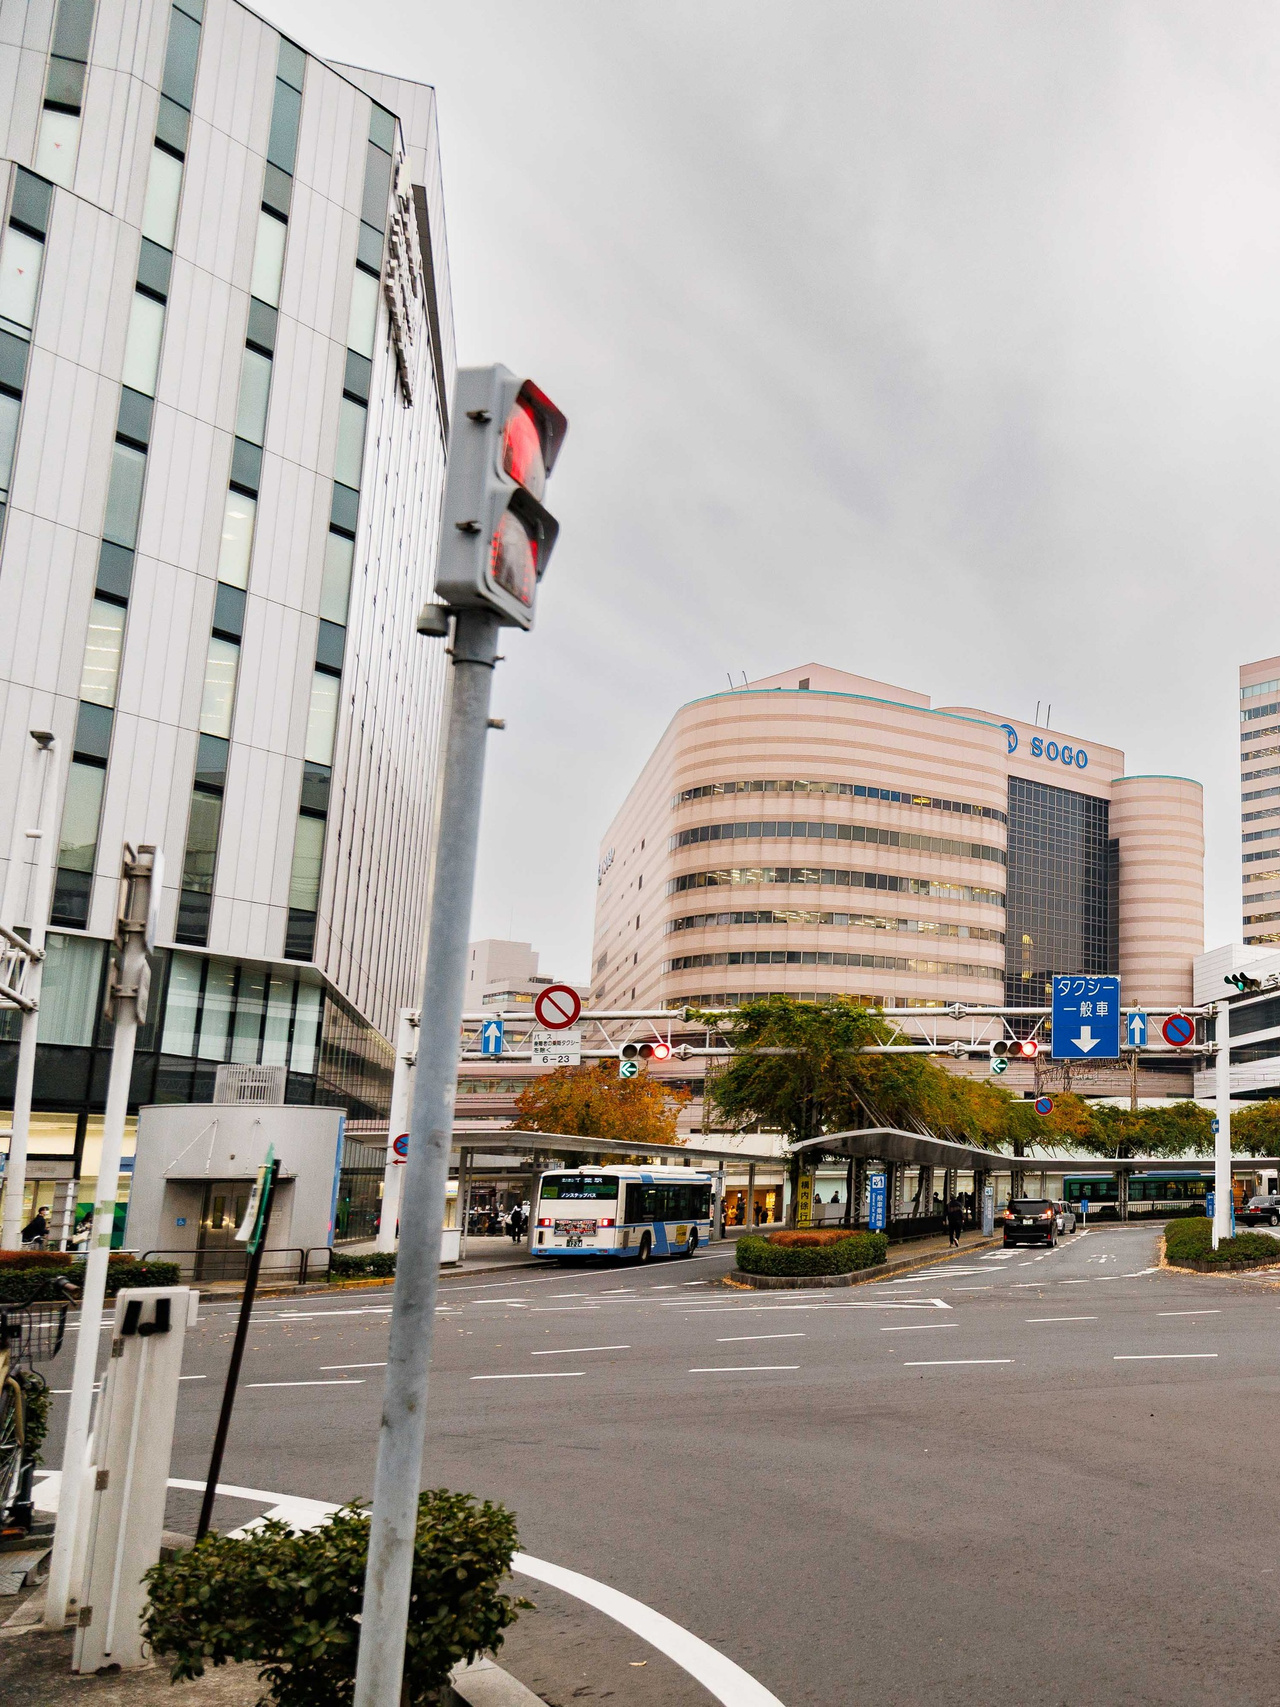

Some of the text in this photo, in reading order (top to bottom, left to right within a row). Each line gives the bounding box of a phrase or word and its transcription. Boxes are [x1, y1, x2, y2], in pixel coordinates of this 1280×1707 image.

[1031, 736, 1088, 769] SOGO
[1058, 980, 1115, 997] タクシー
[1063, 1000, 1109, 1018] 一般車
